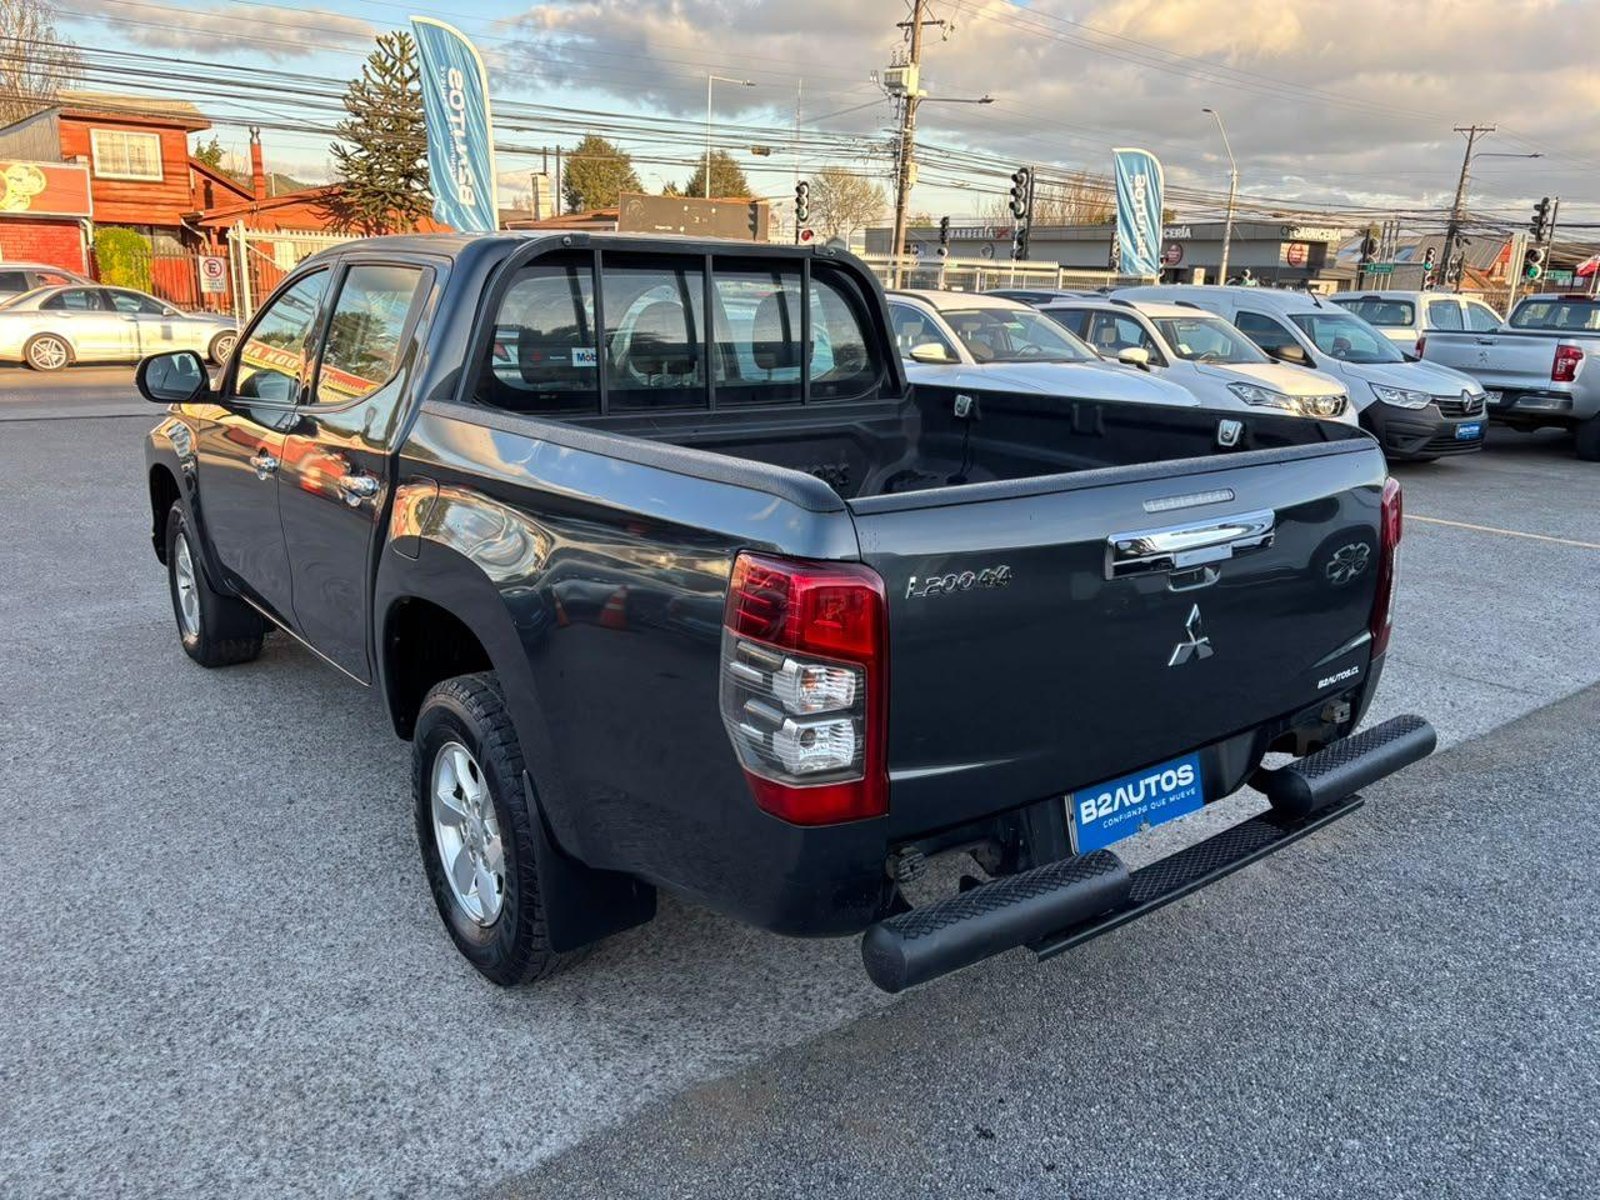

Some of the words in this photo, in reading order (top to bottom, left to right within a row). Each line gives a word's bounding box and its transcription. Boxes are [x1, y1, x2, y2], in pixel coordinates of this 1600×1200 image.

[905, 570, 976, 600] L200
[1080, 764, 1195, 825] B2AUTOS
[1103, 804, 1148, 828] CONFIANZA
[1150, 798, 1167, 810] QUE
[1169, 787, 1197, 803] MUEVE
